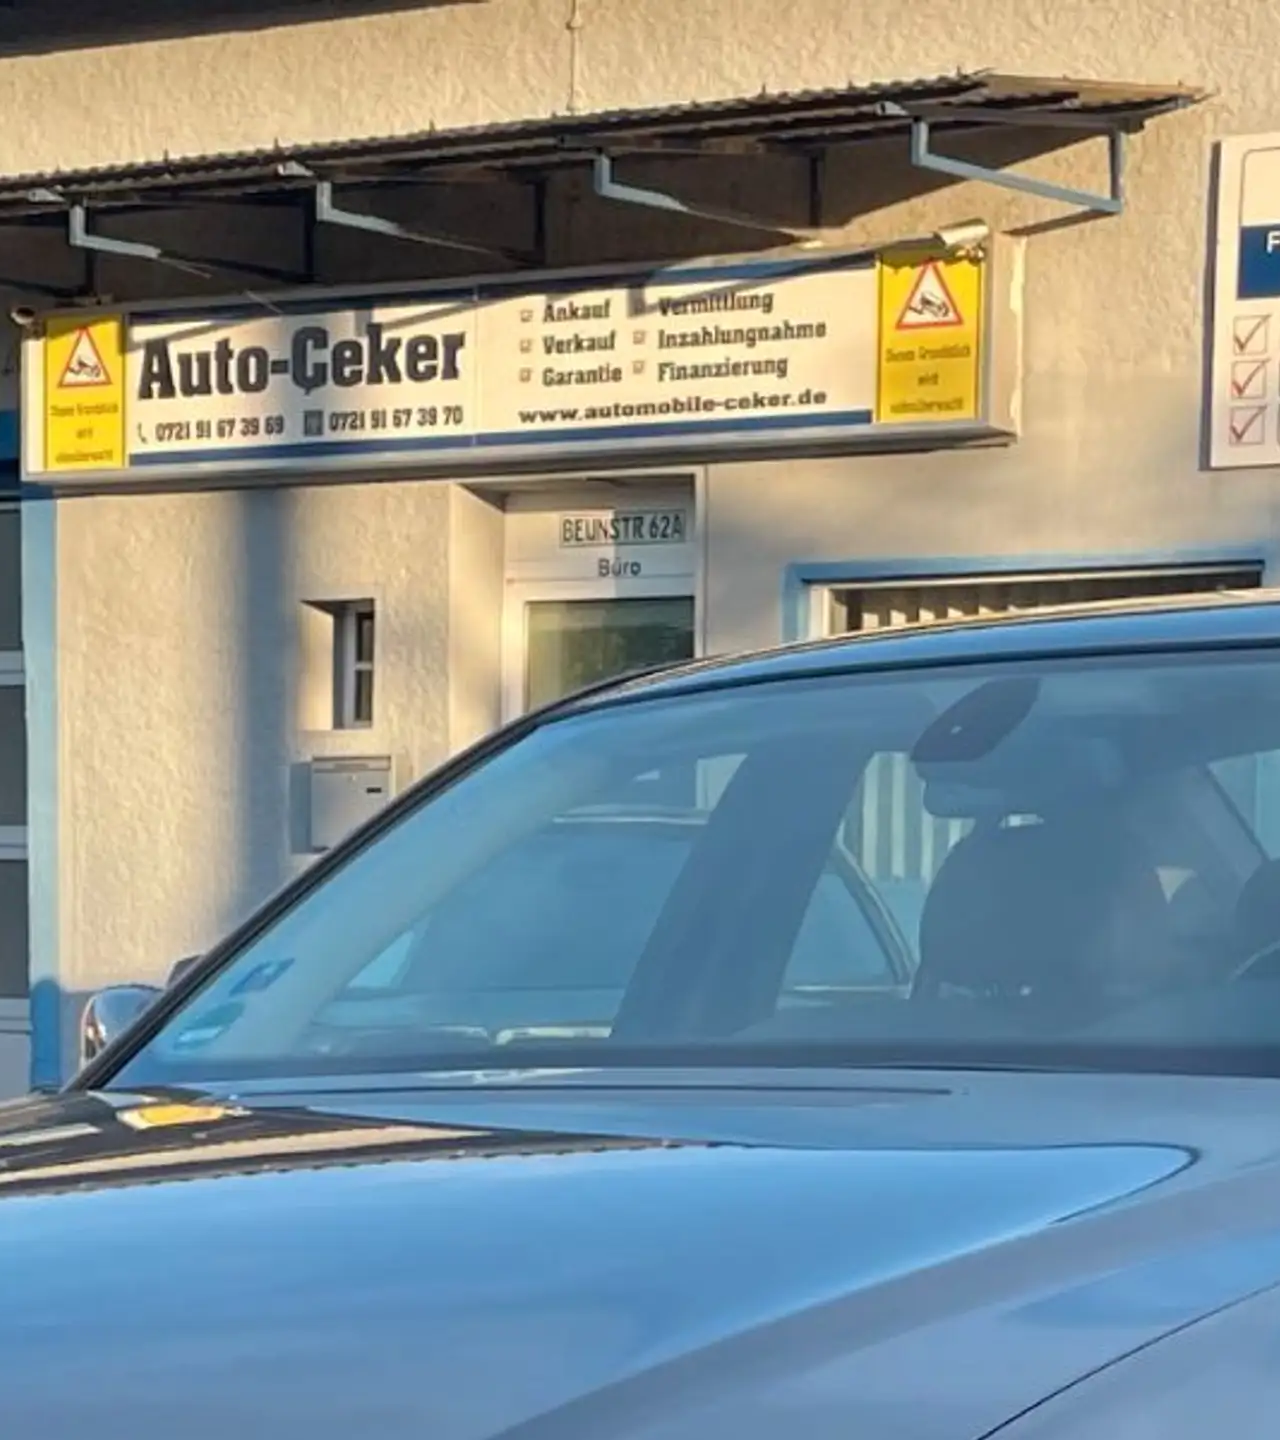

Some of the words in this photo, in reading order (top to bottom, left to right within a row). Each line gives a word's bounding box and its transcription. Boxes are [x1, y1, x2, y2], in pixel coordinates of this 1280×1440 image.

[542, 299, 612, 324] Ankauf
[657, 291, 775, 316] Vermittlung
[542, 330, 618, 355] Verkauf
[657, 321, 828, 349] Inzahlungnahme
[541, 363, 623, 387] Garantie
[656, 356, 789, 384] Finanzierung
[328, 410, 366, 433] 0721
[442, 405, 464, 426] 70
[517, 388, 828, 425] www.automobile-ceker.de
[155, 421, 191, 442] 0721
[598, 556, 642, 578] Büro
